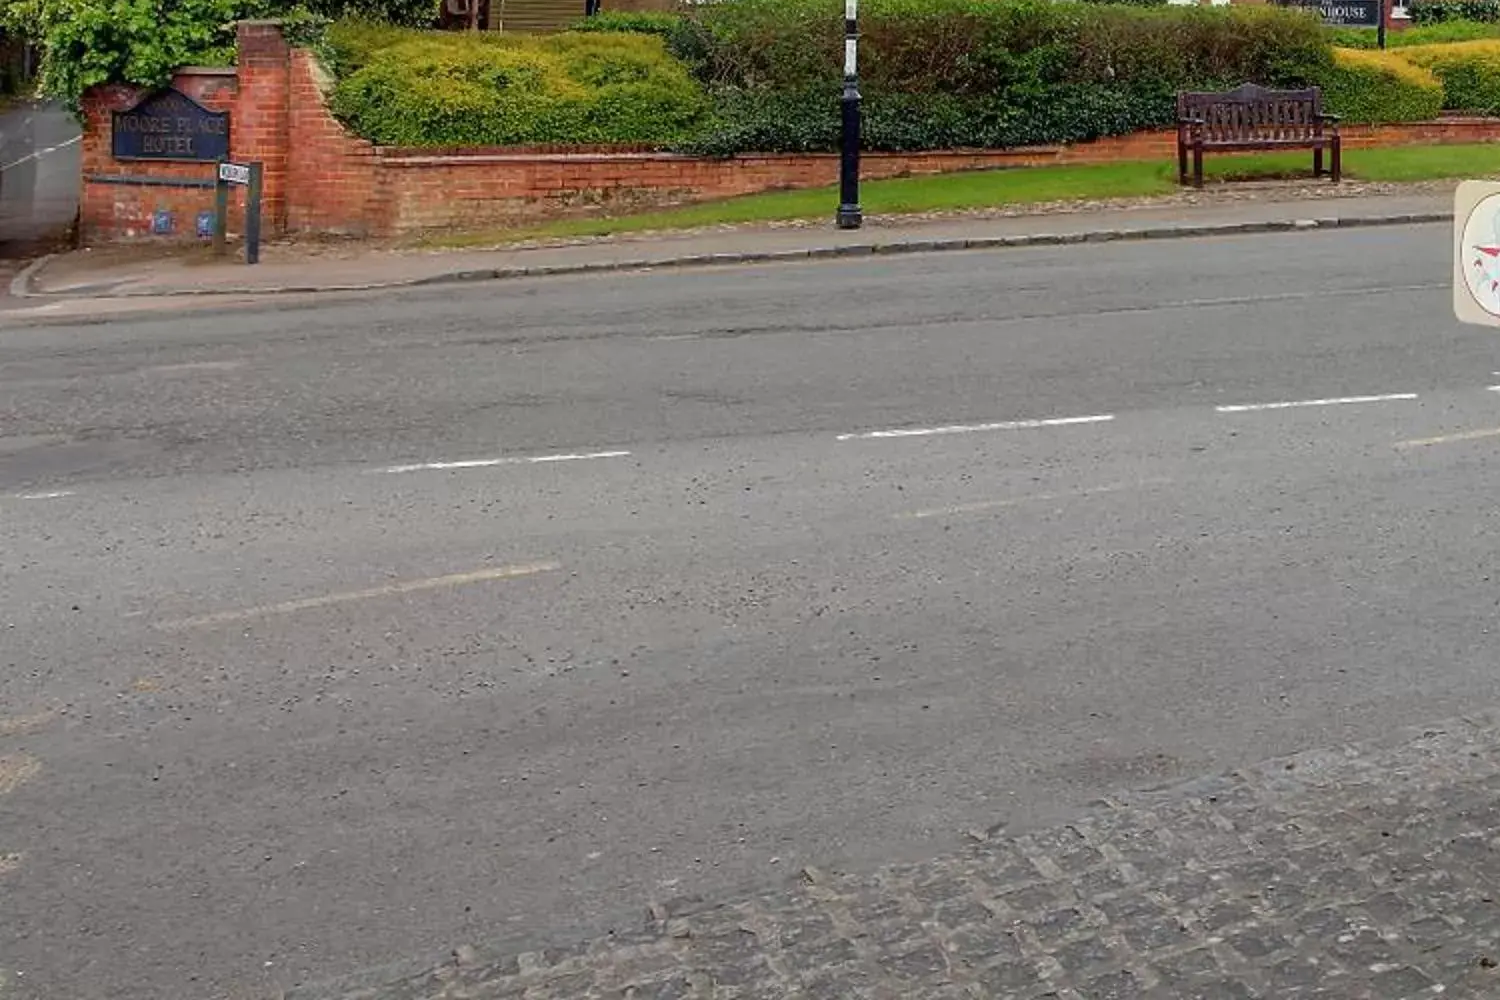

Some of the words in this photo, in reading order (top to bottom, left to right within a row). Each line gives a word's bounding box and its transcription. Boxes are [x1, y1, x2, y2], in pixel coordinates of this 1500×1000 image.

[115, 115, 170, 133] MOORE
[177, 116, 225, 135] PLACE
[142, 135, 193, 153] HOTEL
